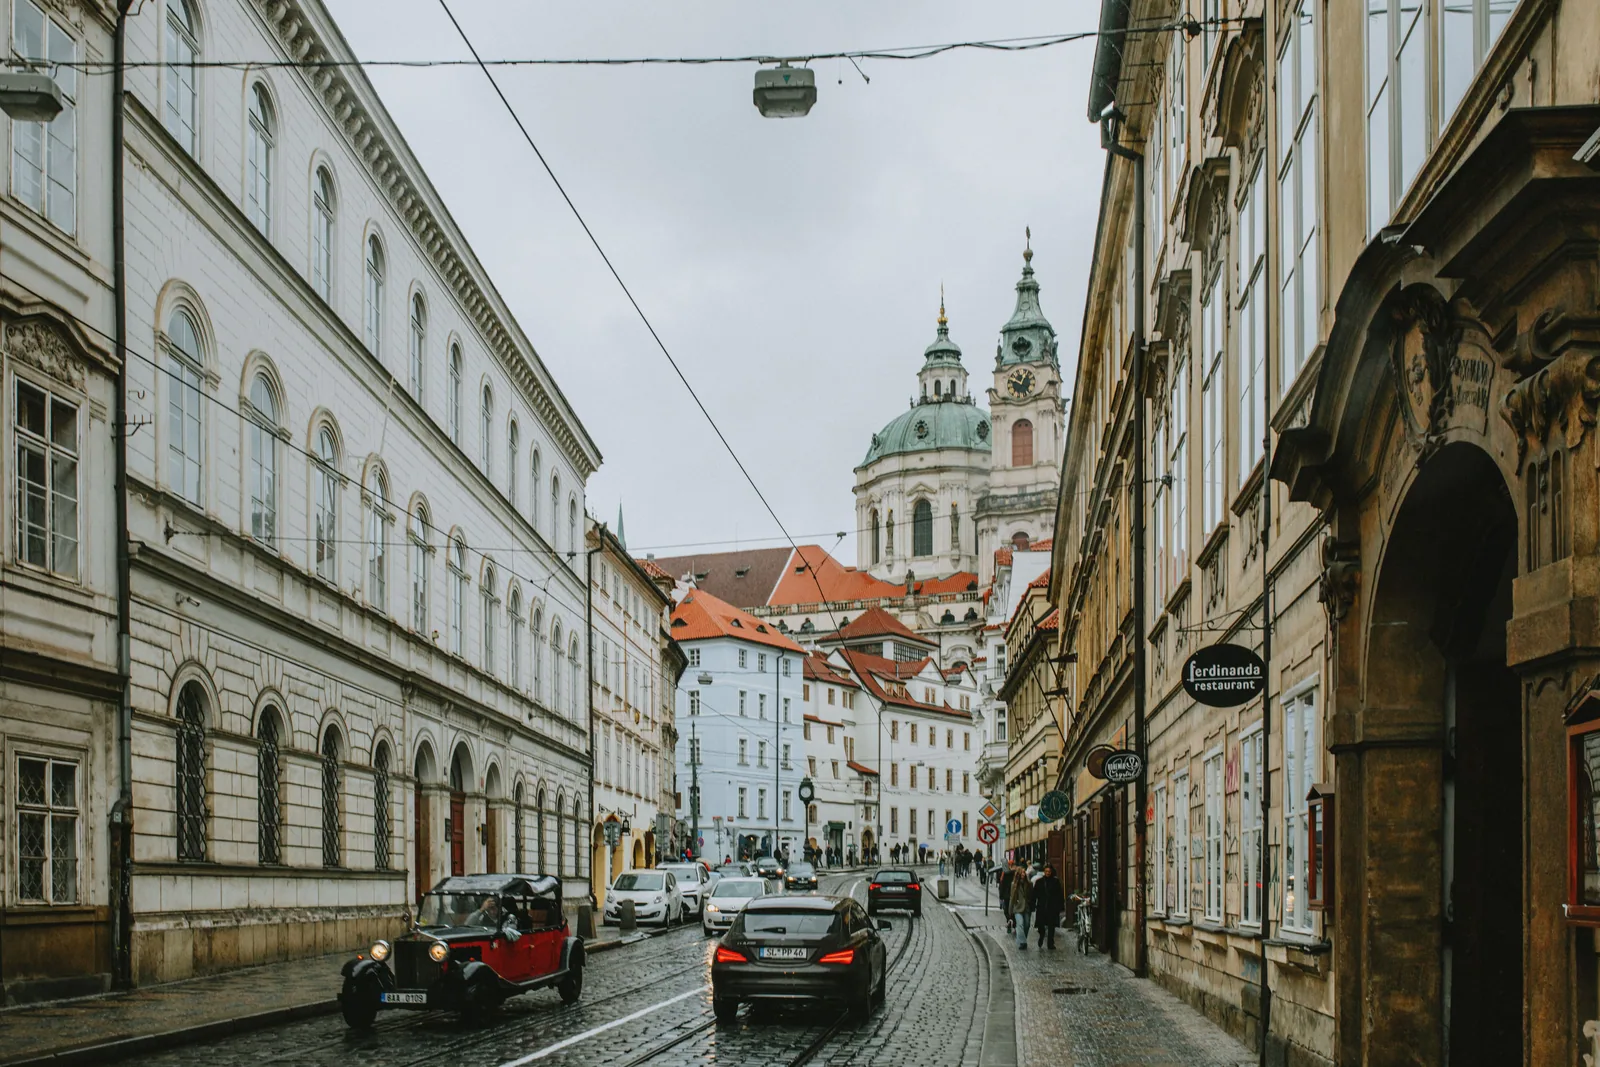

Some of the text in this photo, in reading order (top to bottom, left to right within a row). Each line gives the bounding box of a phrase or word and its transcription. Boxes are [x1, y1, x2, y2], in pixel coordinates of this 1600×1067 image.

[1190, 660, 1260, 682] ferdinanda
[1195, 680, 1255, 691] restaurant
[766, 948, 803, 957] SL PP 46
